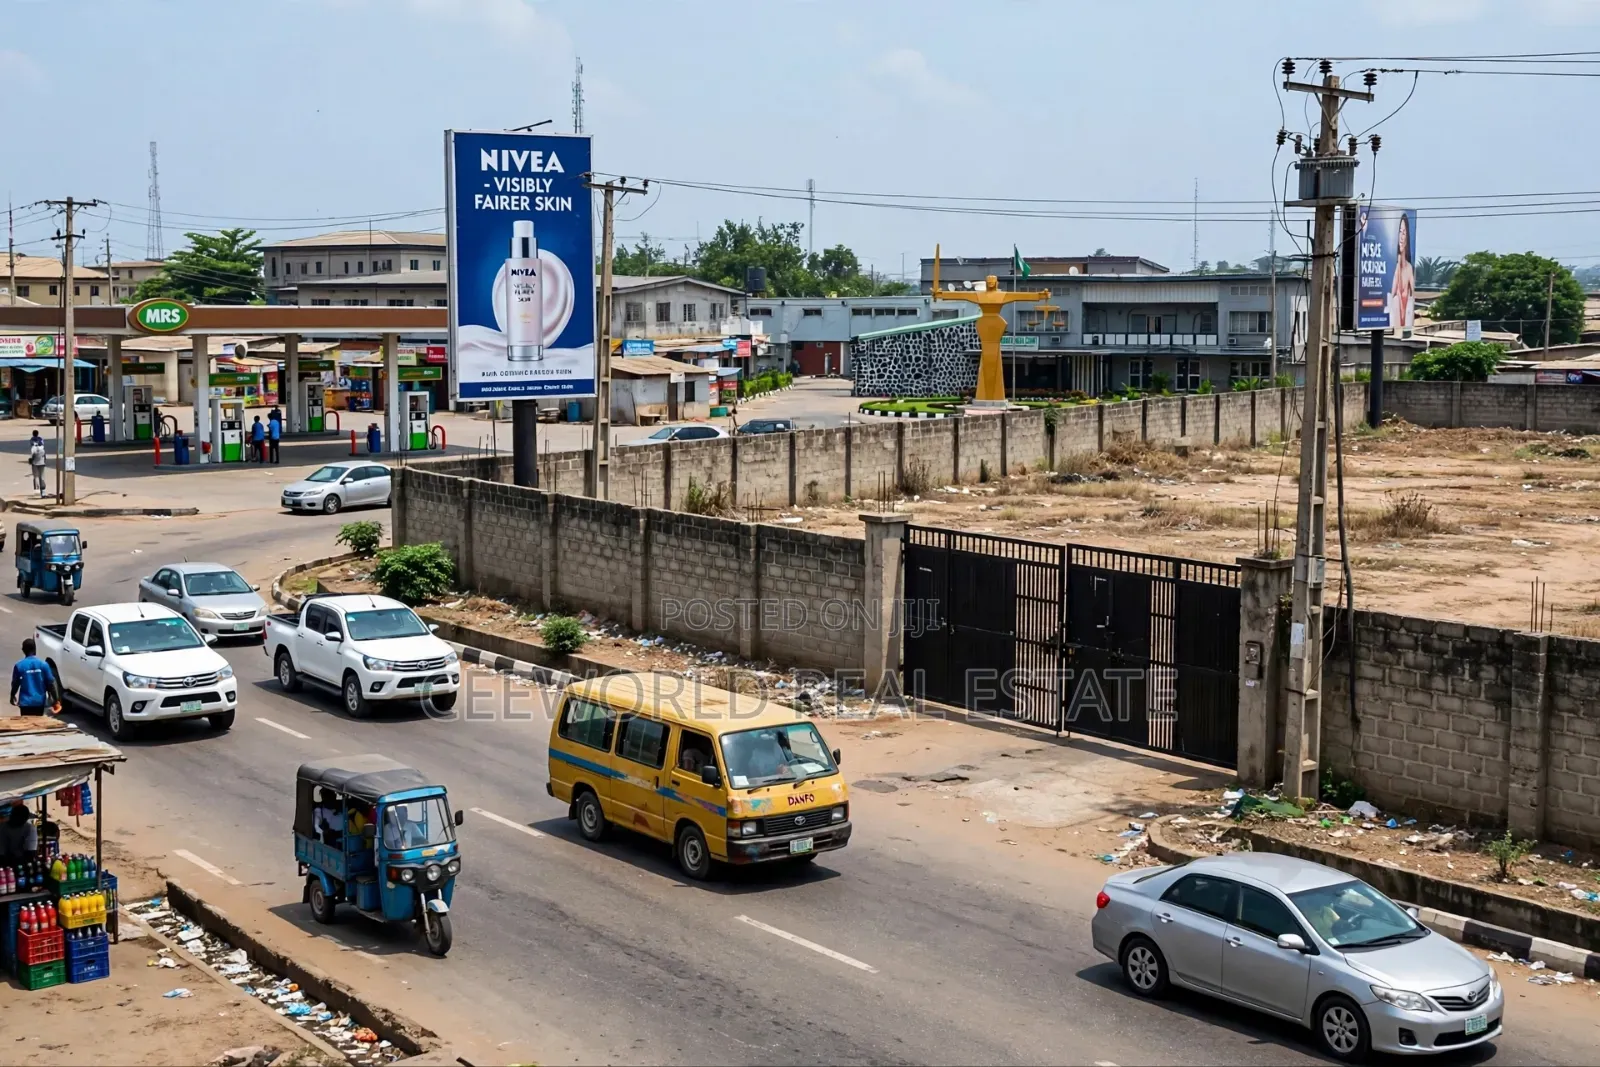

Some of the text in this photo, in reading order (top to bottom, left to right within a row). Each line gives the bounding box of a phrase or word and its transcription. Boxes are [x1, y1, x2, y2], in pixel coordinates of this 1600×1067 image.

[480, 148, 565, 173] NIVEA
[493, 176, 553, 193] VISIBLY
[474, 194, 572, 212] FAIRER SKIN
[511, 268, 537, 276] NIVEA
[146, 308, 181, 323] MRS
[787, 793, 815, 806] DANFO
